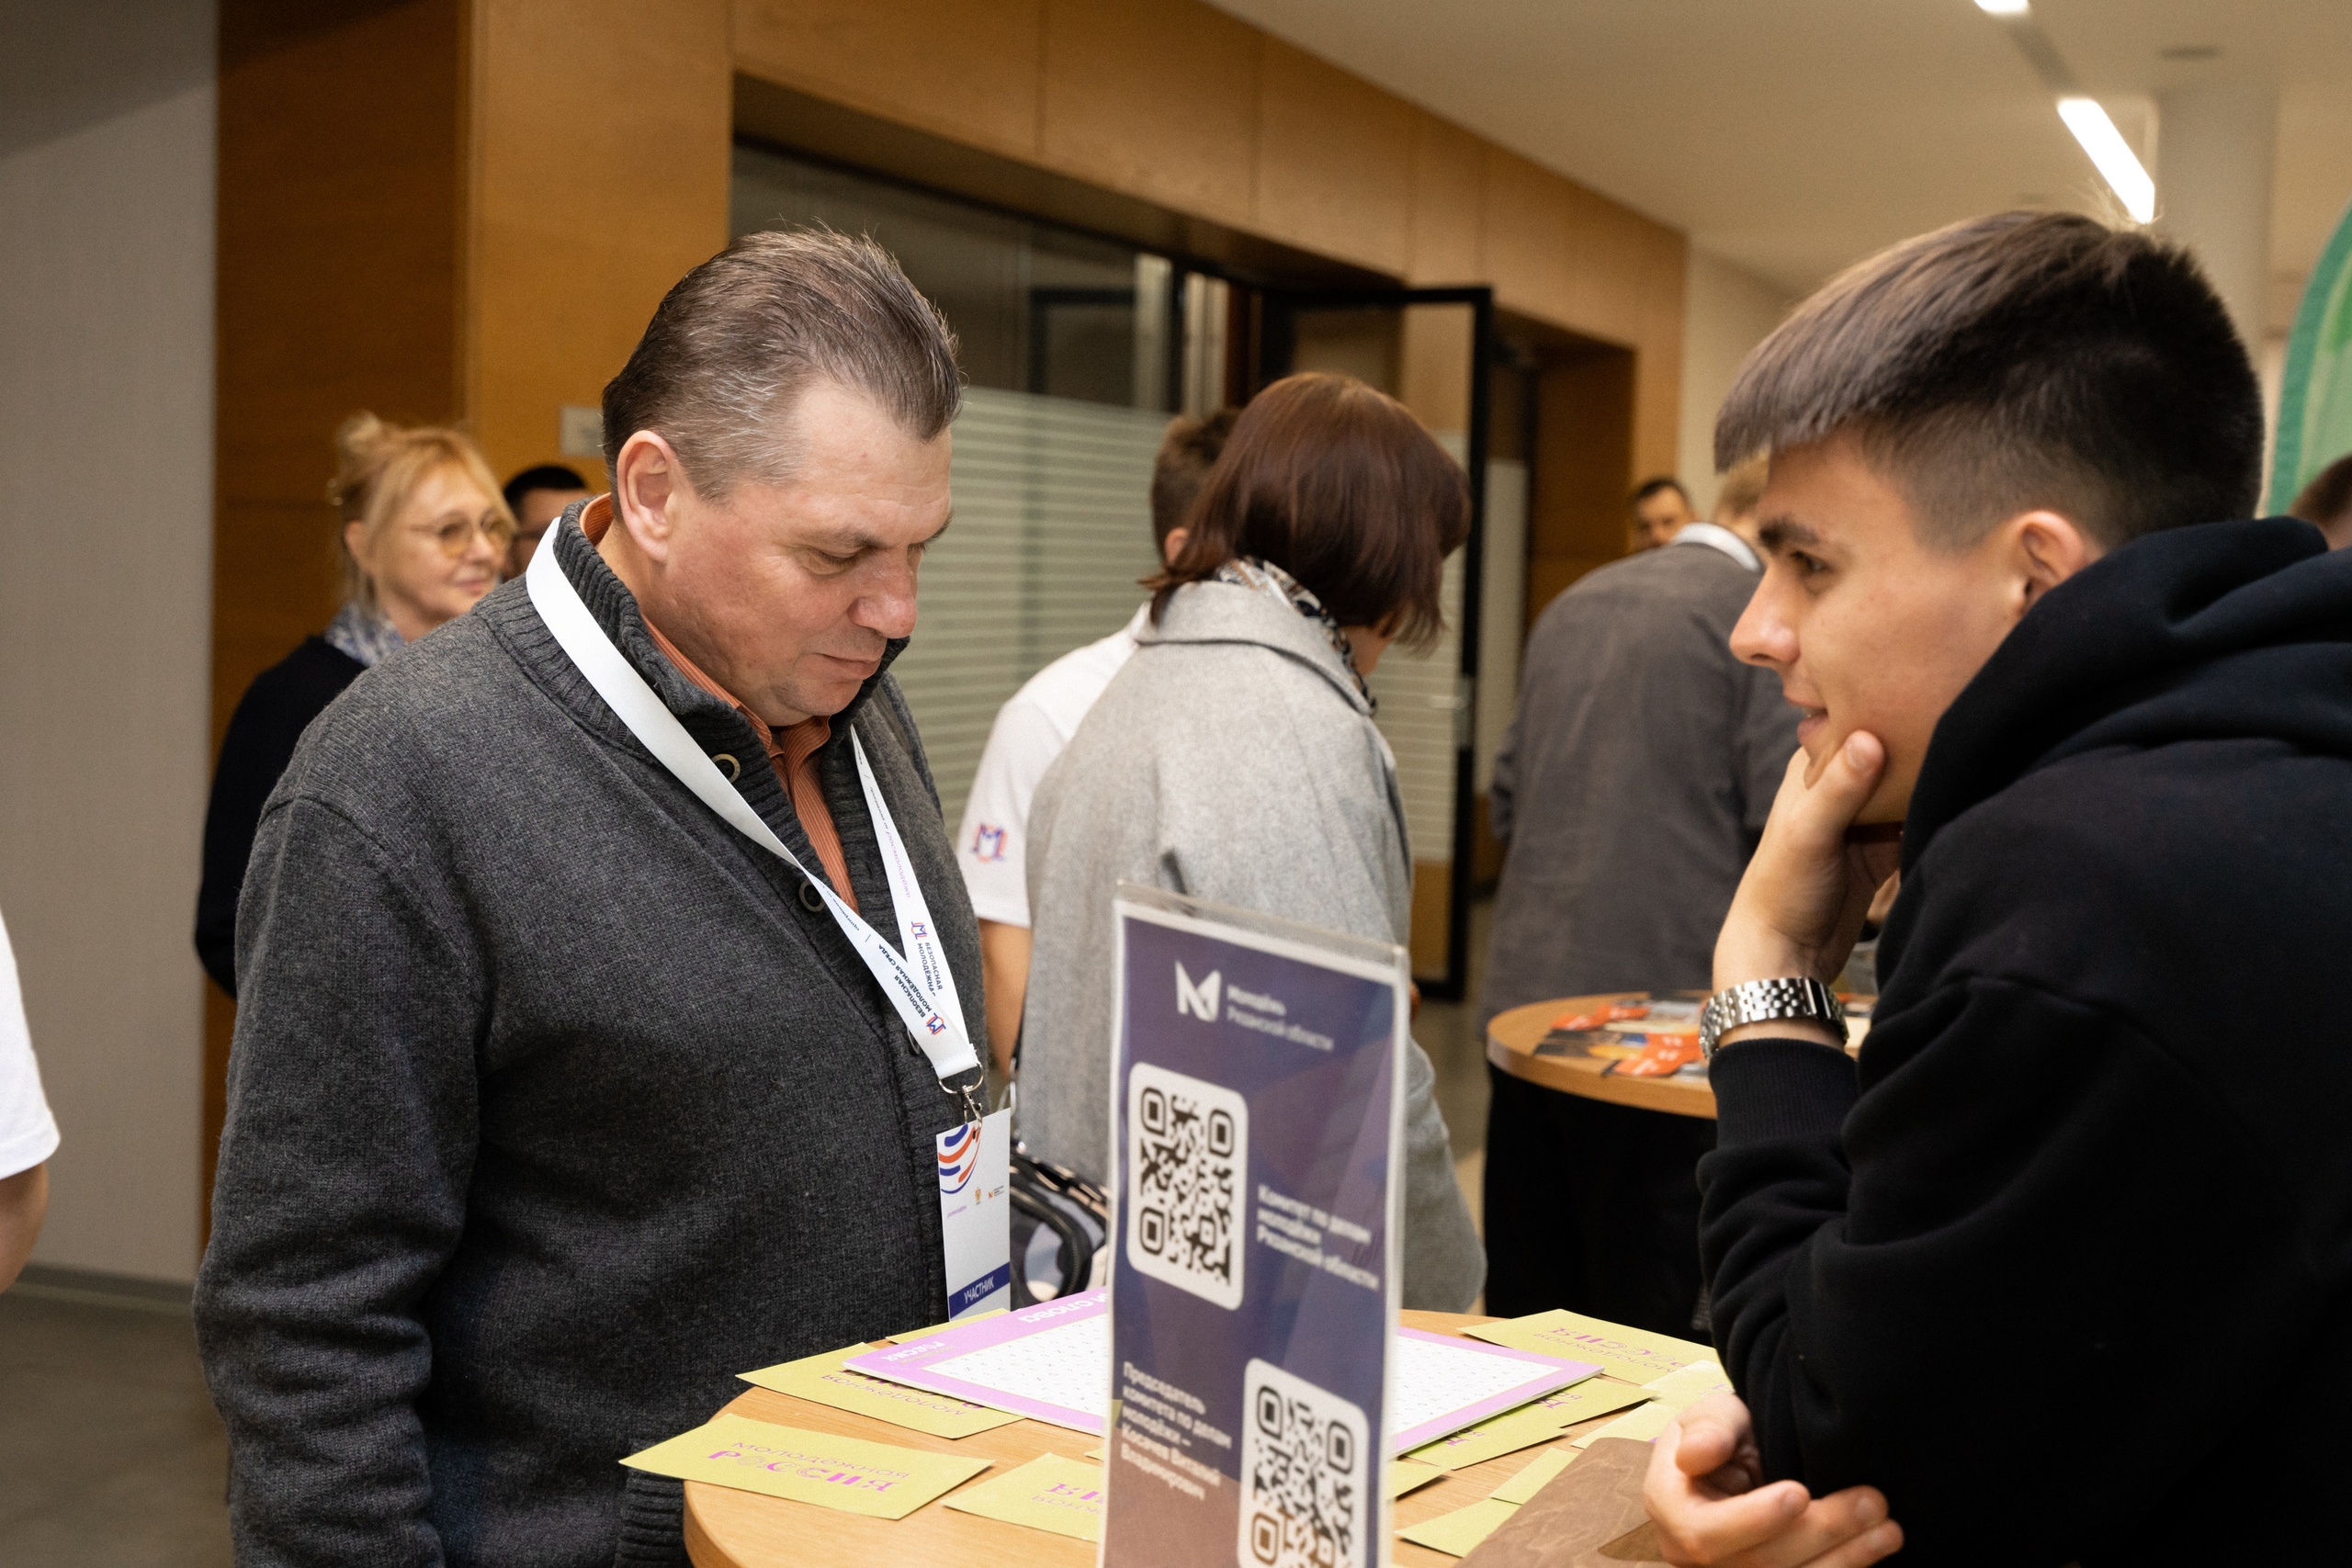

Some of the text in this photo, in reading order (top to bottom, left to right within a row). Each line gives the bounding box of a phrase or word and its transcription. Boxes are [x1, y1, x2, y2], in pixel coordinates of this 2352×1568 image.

[878, 943, 932, 1013] МОЛОДЁЖНАЯ СРЕДА
[917, 942, 936, 997] МОЛОДЁЖНА
[925, 942, 944, 990] БЕЗОПАСНАЯ
[894, 975, 926, 1018] БЕЗОПАСНАЯ
[964, 1275, 995, 1304] УЧАСТНИК
